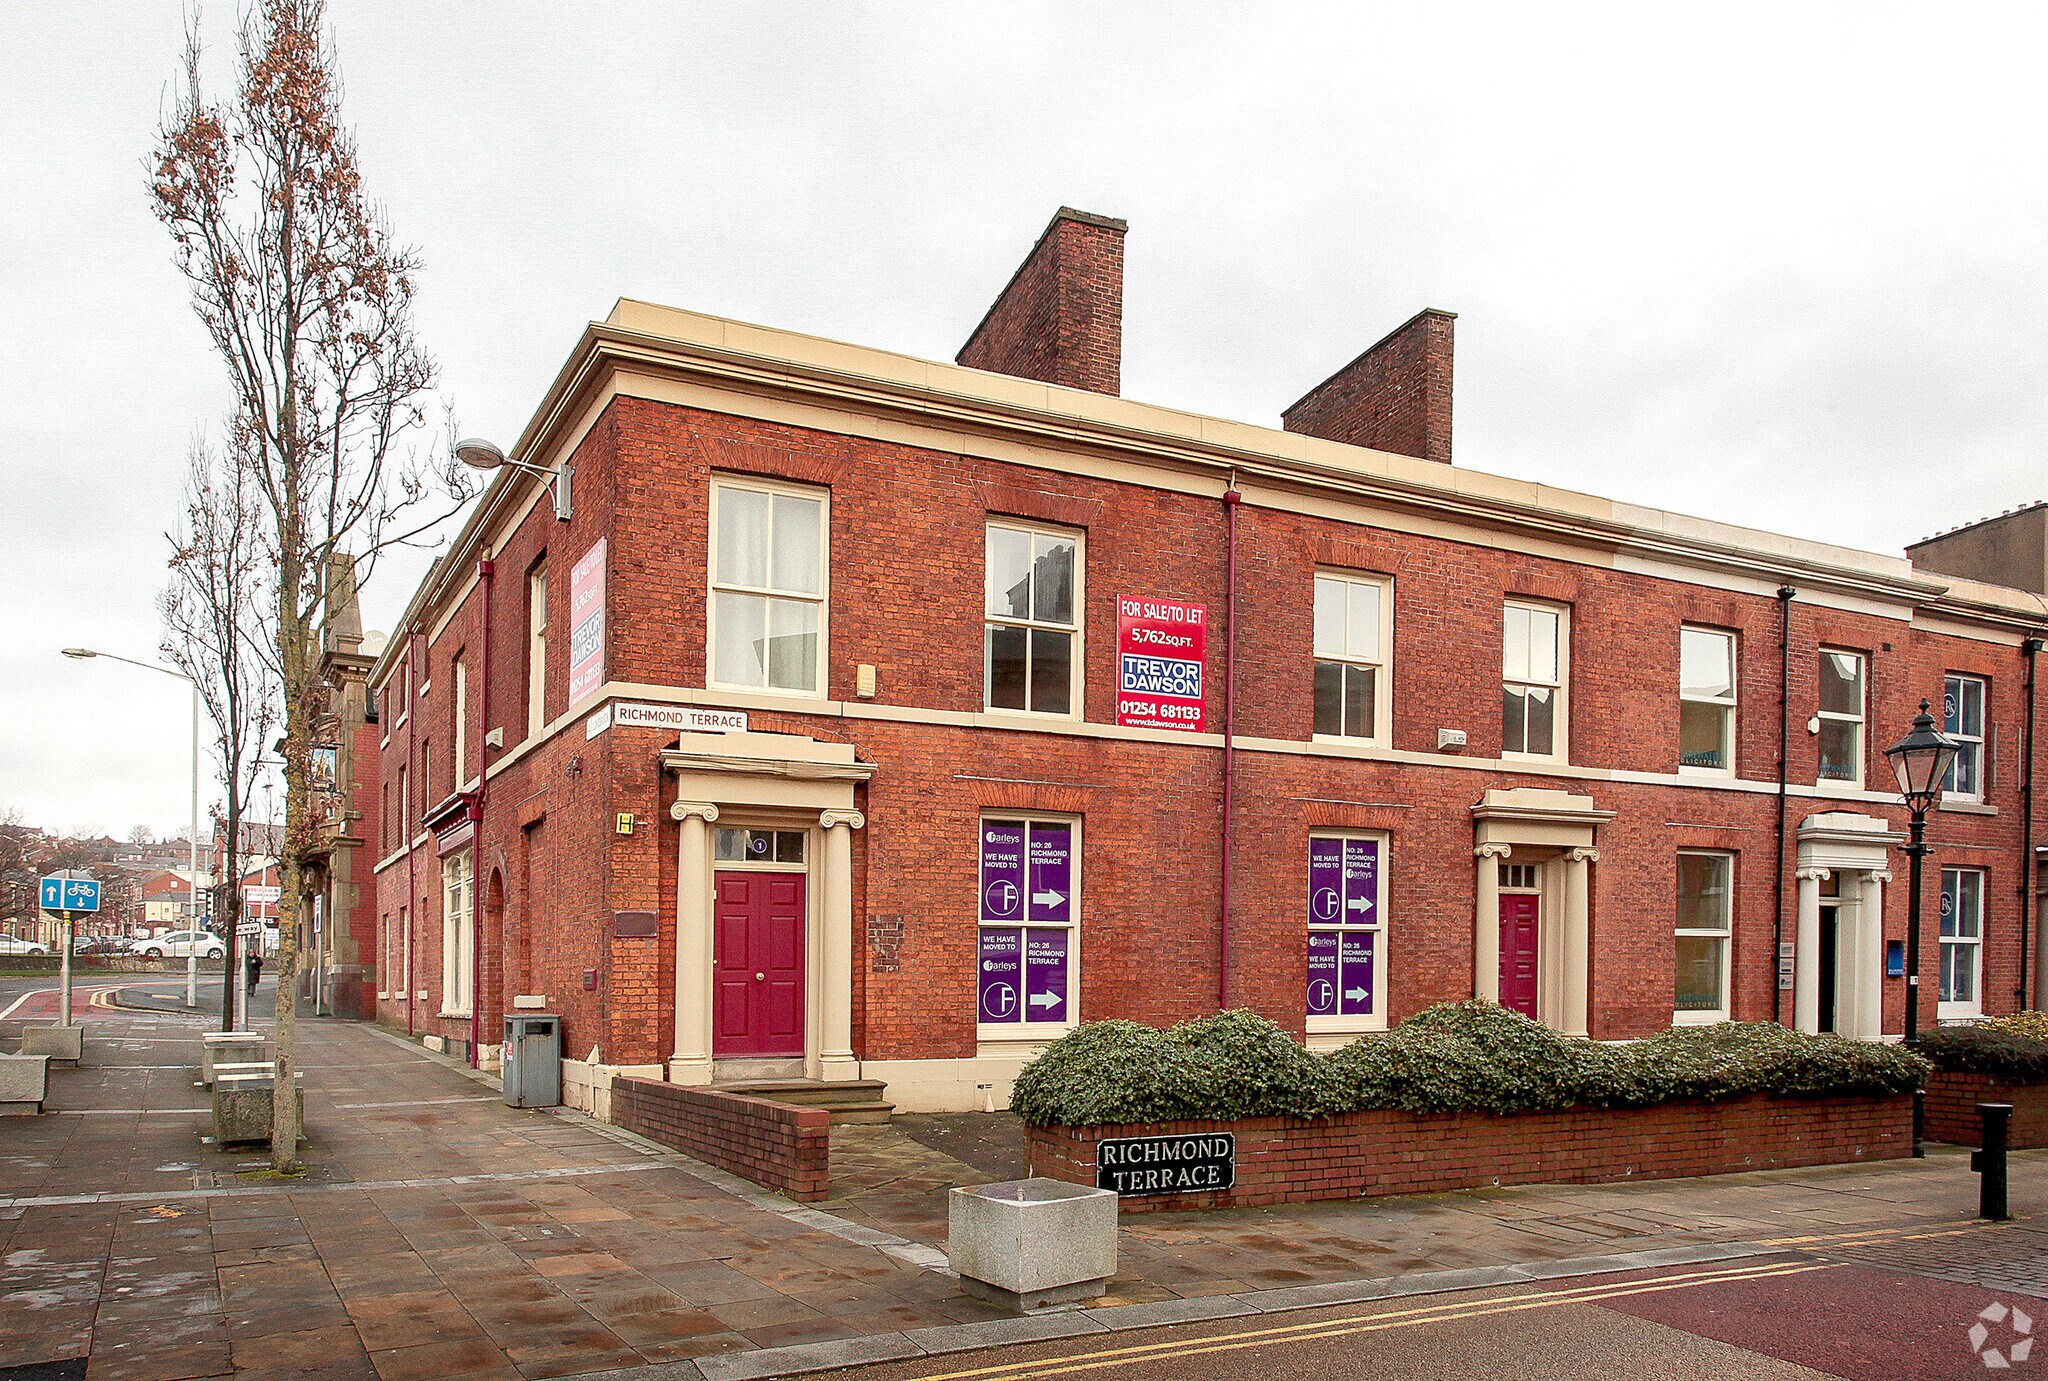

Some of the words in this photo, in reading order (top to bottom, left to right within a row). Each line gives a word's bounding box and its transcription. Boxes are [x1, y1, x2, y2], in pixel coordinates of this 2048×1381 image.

[1122, 600, 1140, 616] FOR
[1144, 603, 1183, 622] SALE/TO
[1186, 608, 1203, 624] LET
[1124, 658, 1198, 680] TREVOR
[1124, 673, 1199, 695] DAWSON
[620, 708, 682, 724] RICHMOND
[690, 714, 742, 728] TERRACE
[1120, 700, 1156, 716] 01254
[1160, 704, 1200, 720] 681133
[1681, 757, 1722, 766] OLICITORS
[619, 815, 632, 832] H
[1104, 1138, 1229, 1165] RICHMOND
[1113, 1165, 1220, 1192] TERRACE
